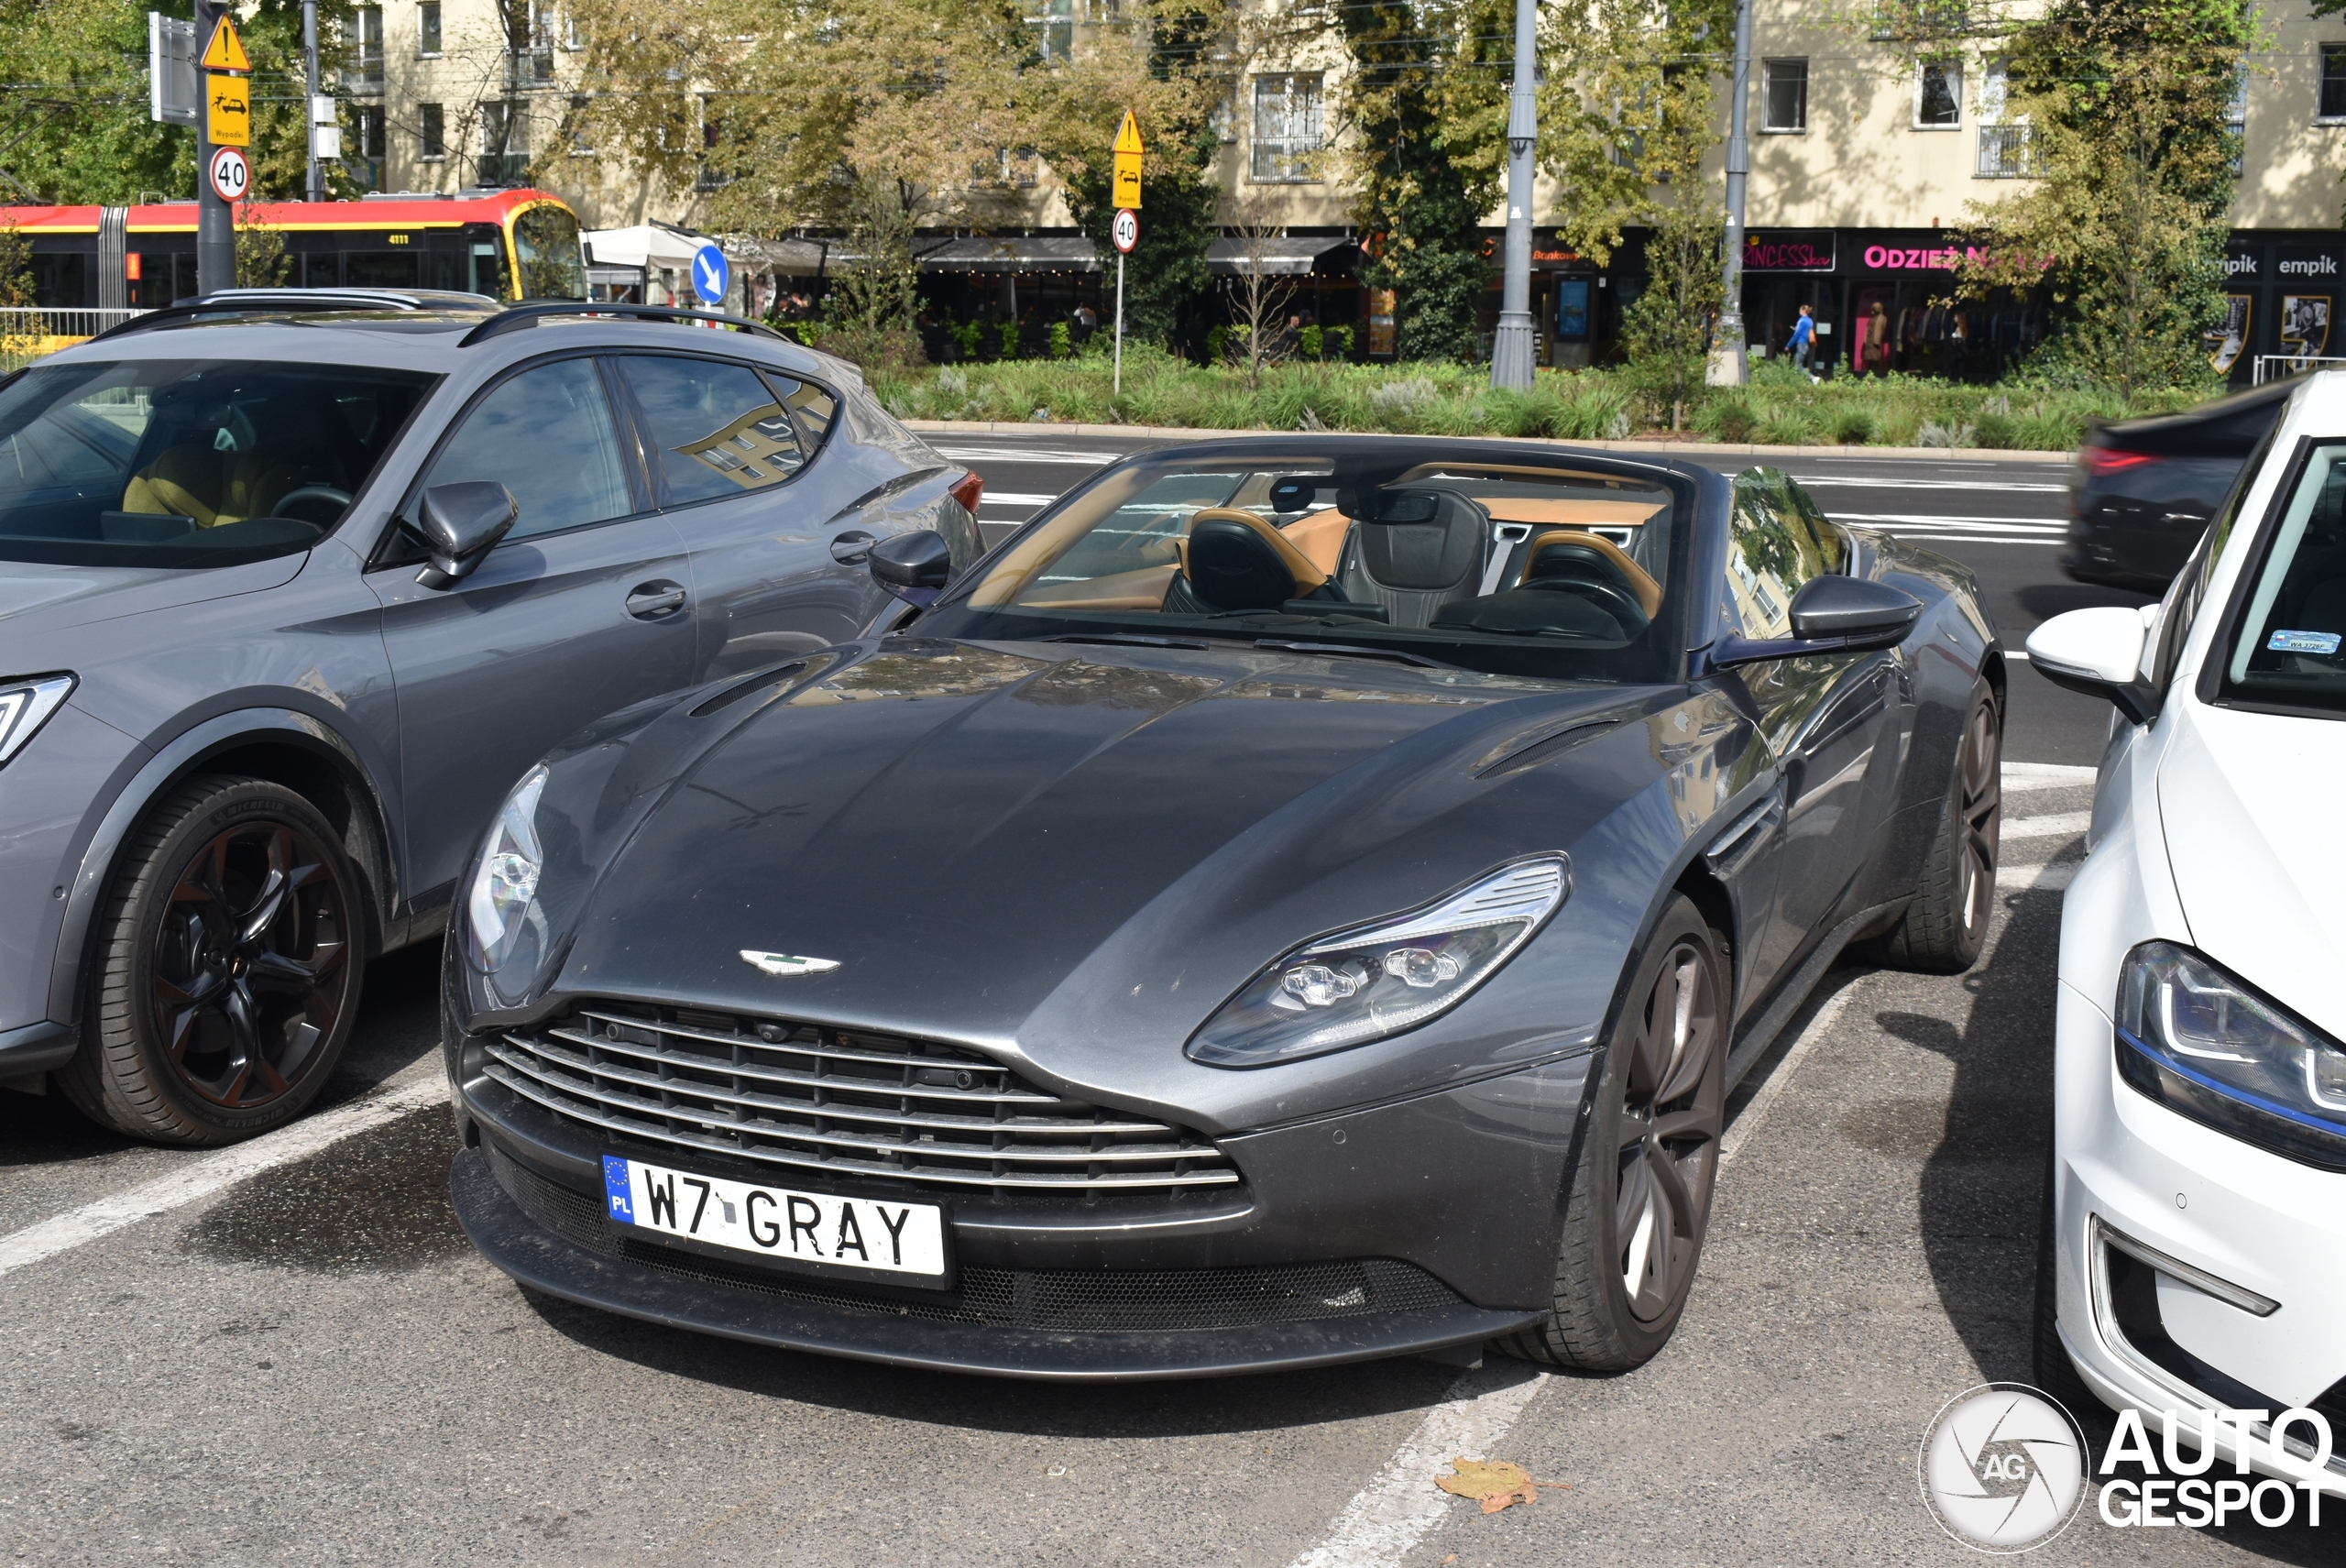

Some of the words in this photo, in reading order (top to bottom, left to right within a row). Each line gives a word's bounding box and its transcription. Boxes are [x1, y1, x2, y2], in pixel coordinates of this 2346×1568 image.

[215, 130, 243, 139] Wypadki
[218, 161, 245, 187] 40
[1118, 221, 1135, 240] 40
[389, 235, 409, 245] 4111
[1532, 250, 1579, 262] Bankowy
[2279, 255, 2337, 277] empik
[227, 800, 285, 817] MICHELIN
[225, 1105, 285, 1127] MICHELIN
[612, 1196, 631, 1214] PL
[644, 1168, 711, 1234] W7
[746, 1190, 910, 1266] GRAY
